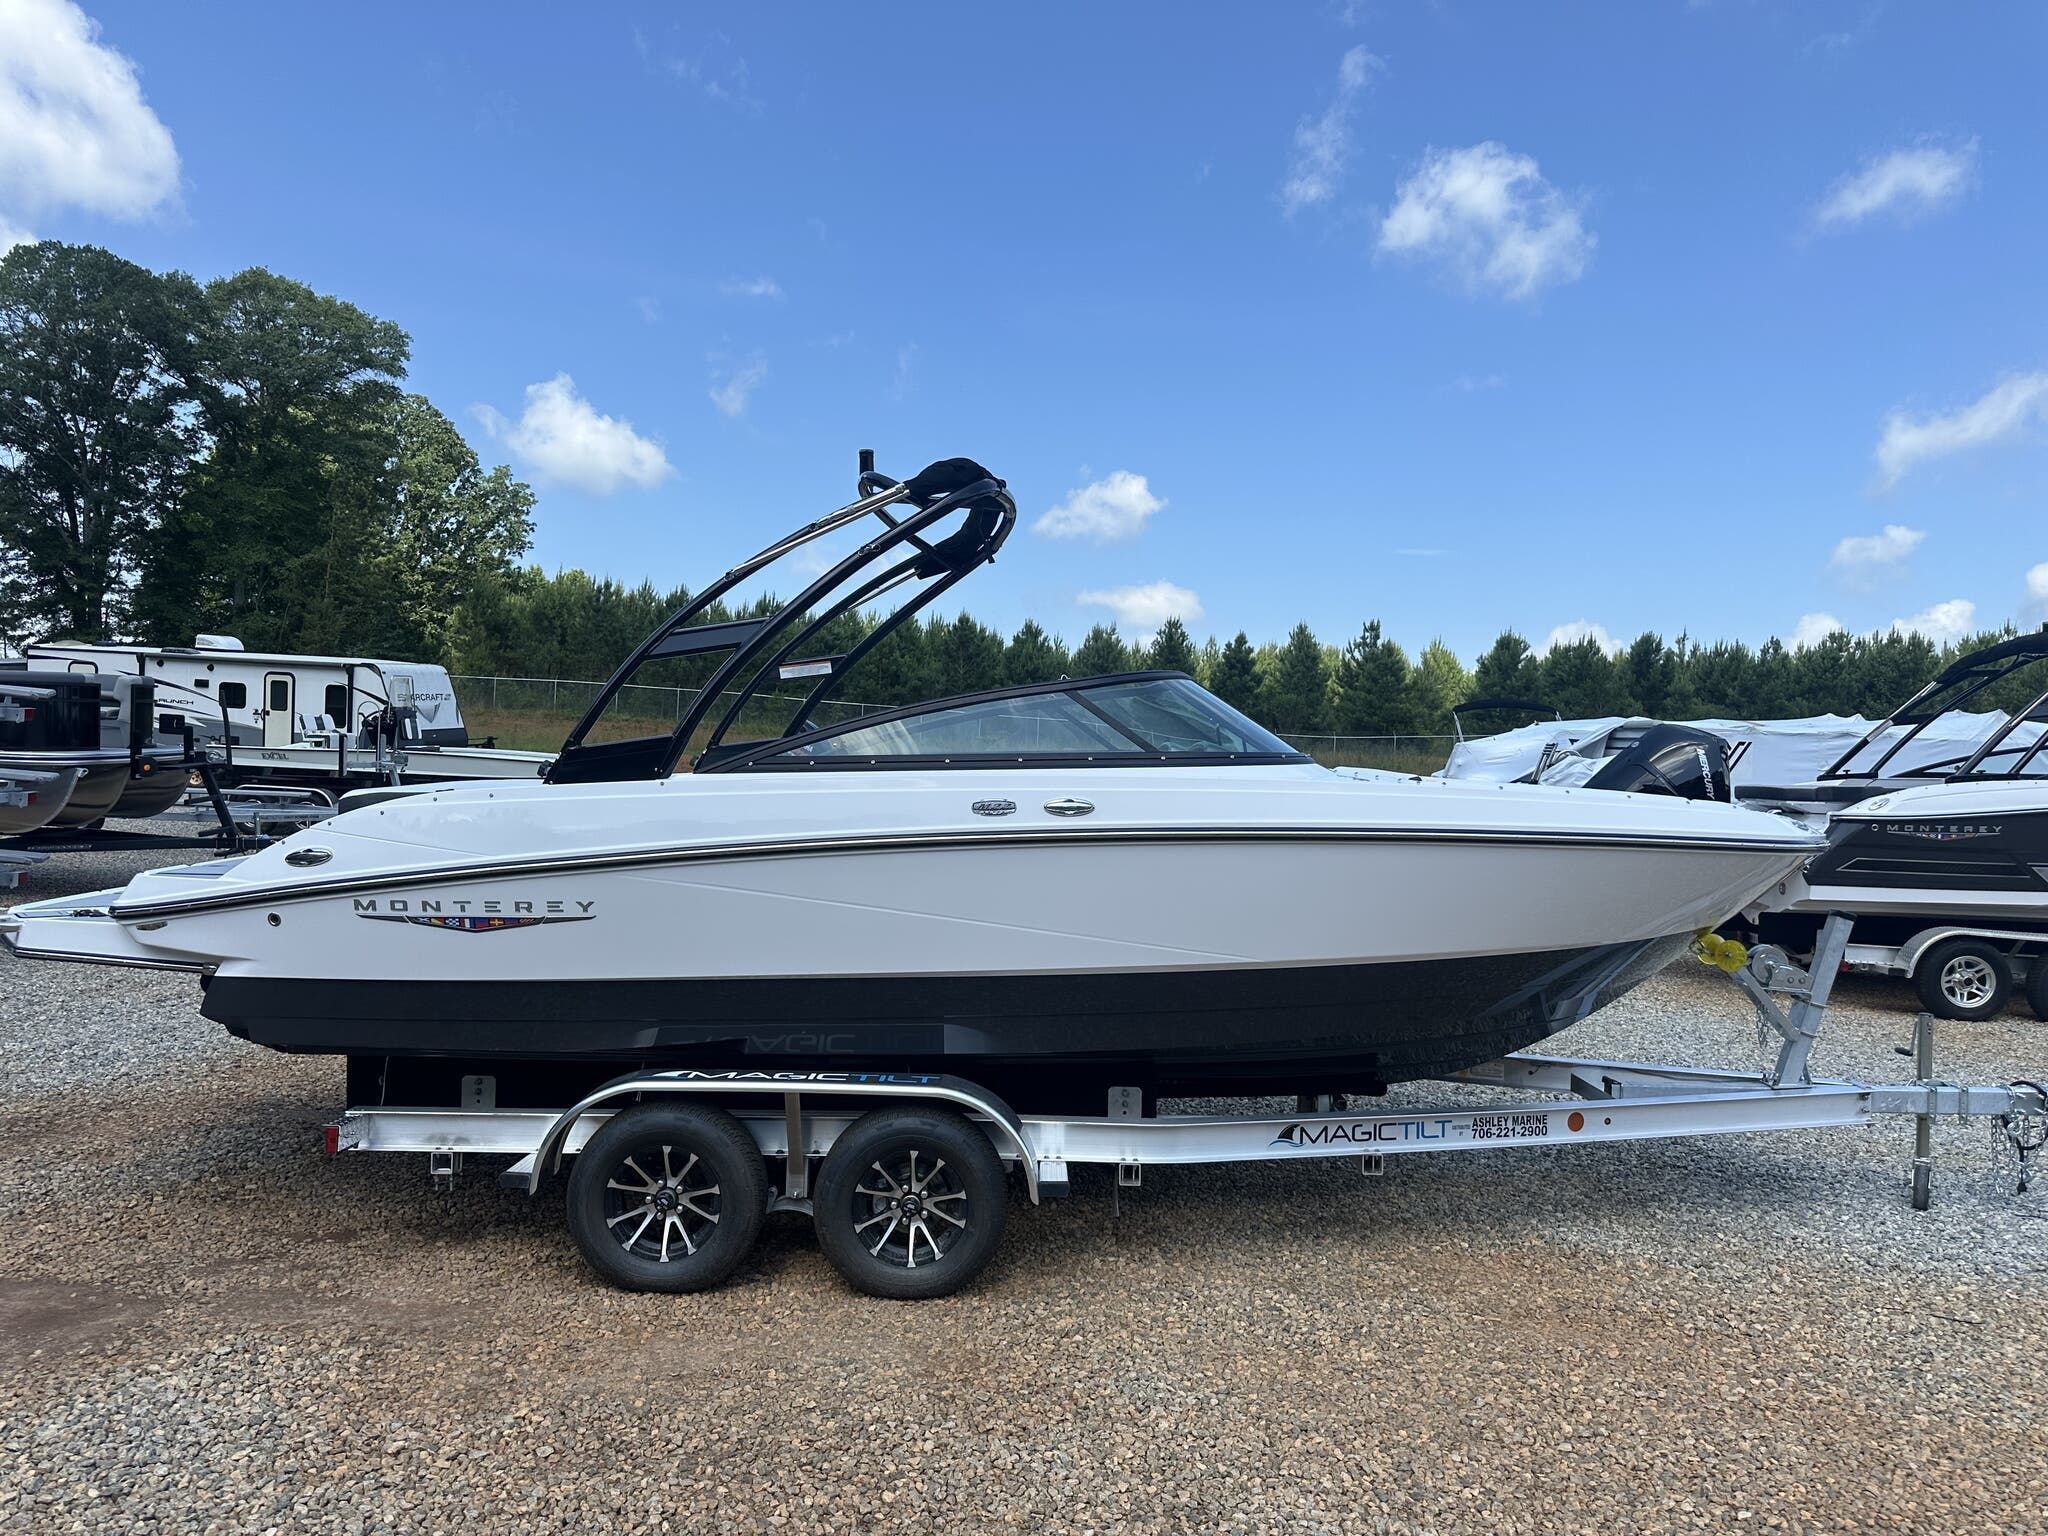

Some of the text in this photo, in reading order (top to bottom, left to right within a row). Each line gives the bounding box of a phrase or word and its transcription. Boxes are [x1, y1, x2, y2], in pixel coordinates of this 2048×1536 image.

[410, 693, 444, 701] ARCRAFT
[261, 752, 289, 760] EXCEL
[1696, 748, 1715, 800] MERCURY
[1886, 824, 2003, 833] MONTEREY
[353, 898, 595, 913] MONTEREY
[686, 1070, 942, 1084] MAGICTILT
[1472, 1114, 1548, 1128] ASHLEY MARINE
[1299, 1119, 1453, 1144] MAGICTILT
[1471, 1125, 1548, 1139] 706-221-2900
